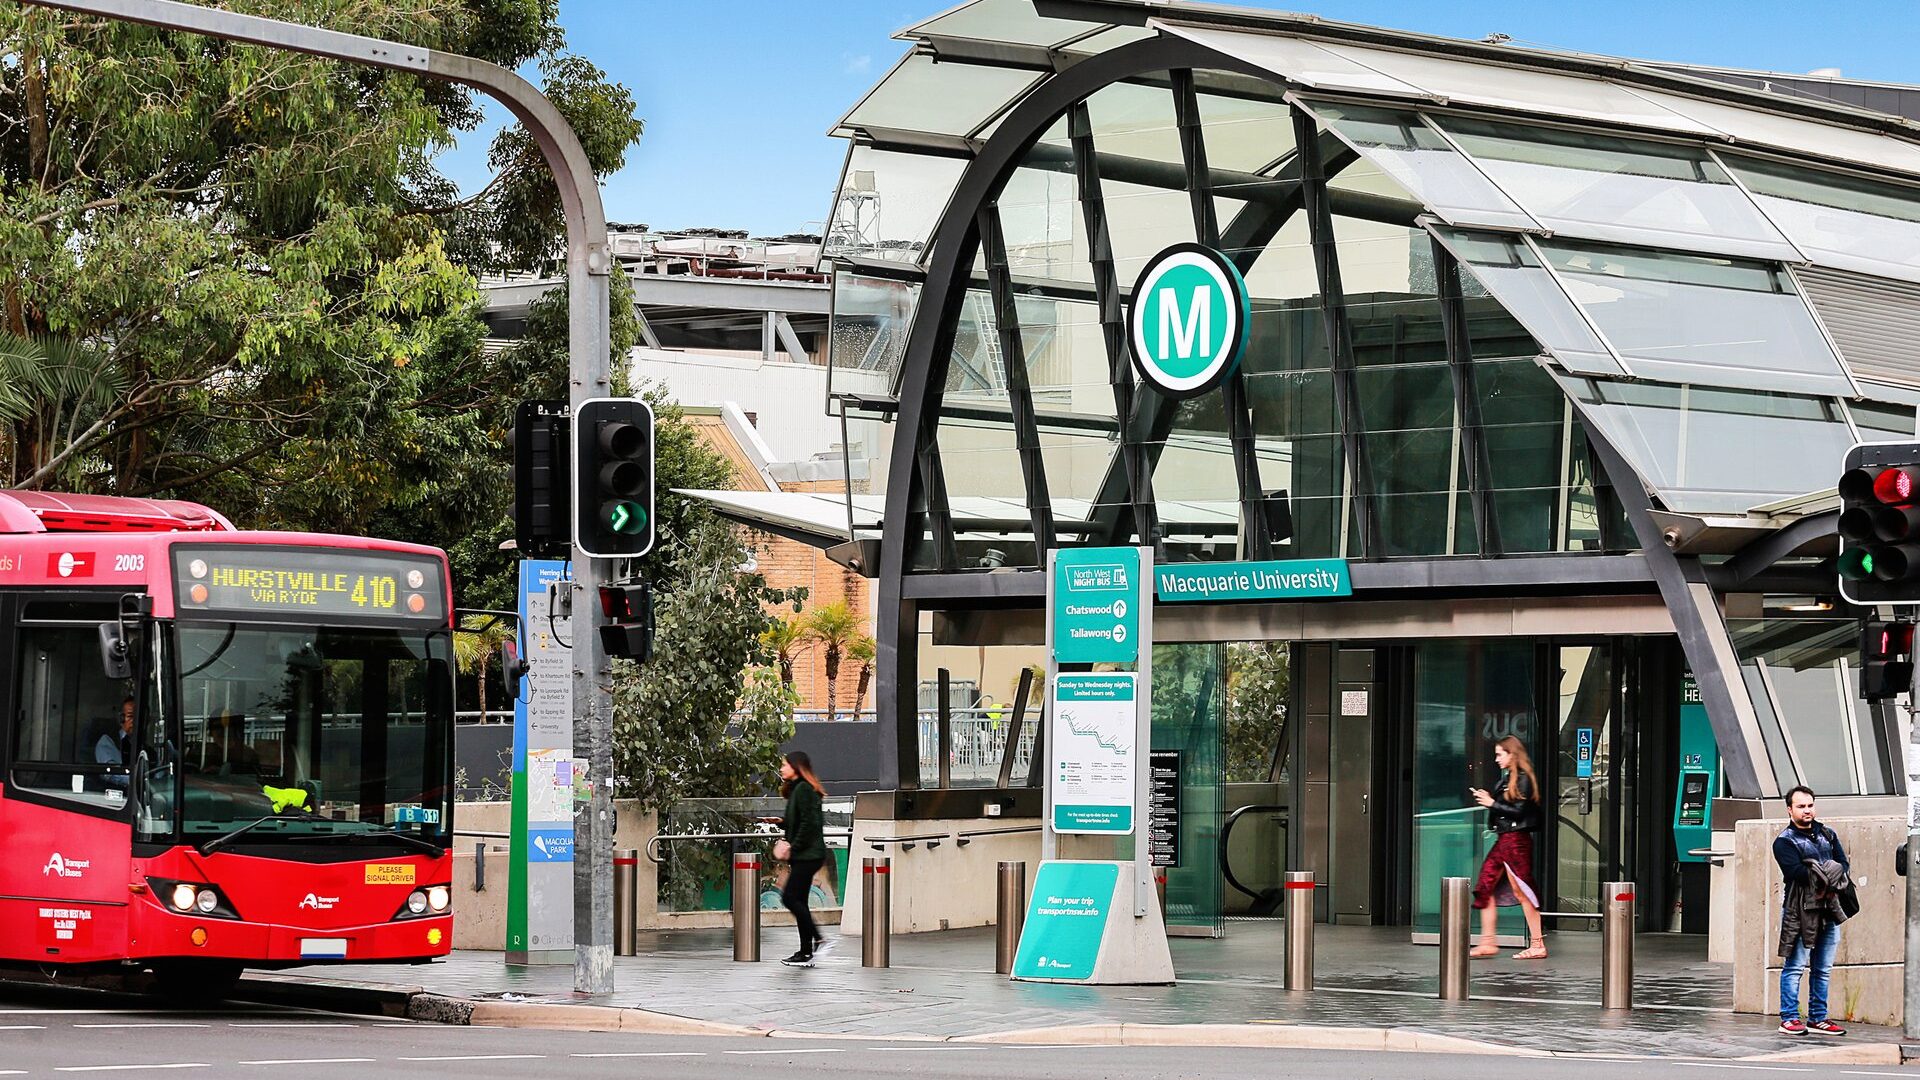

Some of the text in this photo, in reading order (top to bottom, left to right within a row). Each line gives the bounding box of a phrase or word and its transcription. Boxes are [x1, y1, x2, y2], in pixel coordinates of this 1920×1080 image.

[1158, 284, 1210, 360] M
[114, 554, 144, 572] 2003
[540, 569, 560, 578] Herring
[1074, 569, 1111, 578] North West
[1074, 578, 1111, 586] NIGHT BUS
[1161, 568, 1340, 596] Macquarie University
[212, 568, 396, 608] HURSTVILLE 410
[251, 588, 318, 604] VIA RYDE
[1066, 605, 1112, 616] Chatswood
[1070, 628, 1112, 640] Tallawong
[1047, 896, 1094, 906] Plan your trip
[1038, 907, 1099, 916] transportnsw.info
